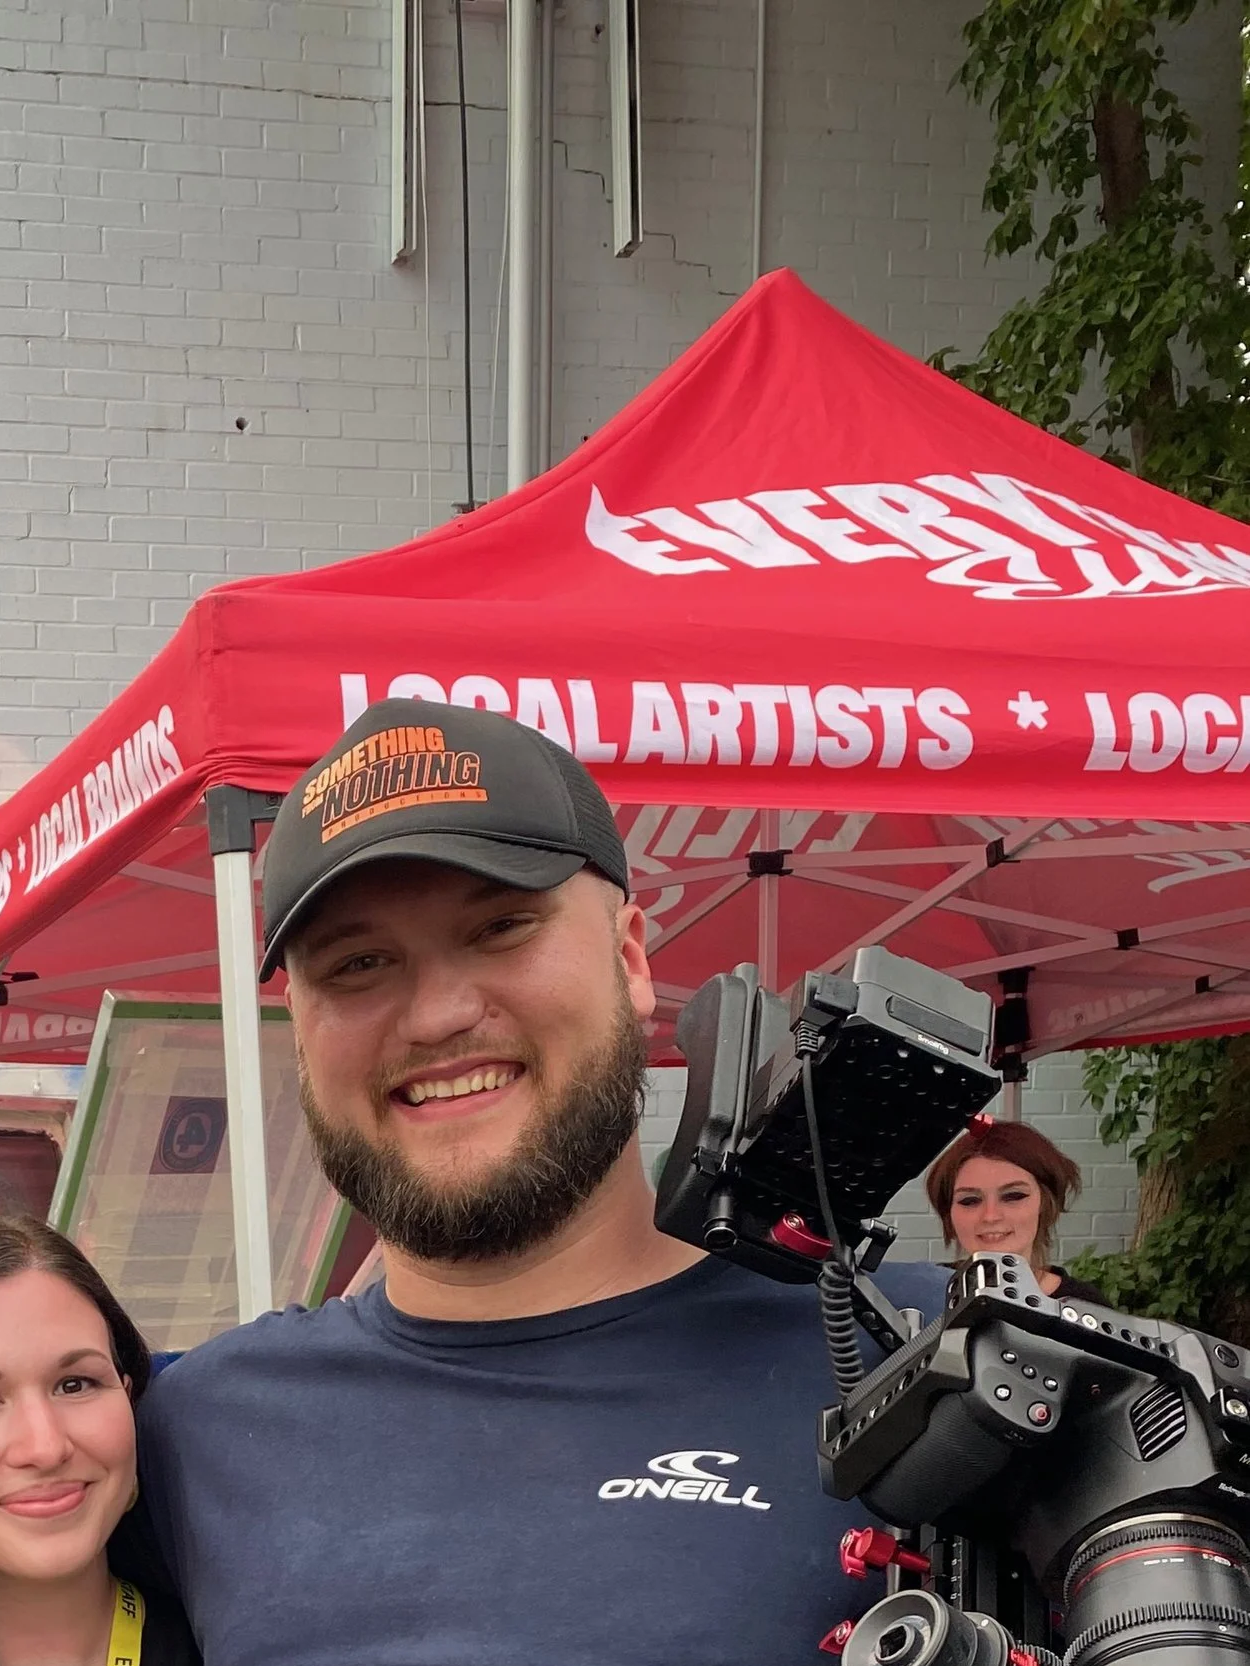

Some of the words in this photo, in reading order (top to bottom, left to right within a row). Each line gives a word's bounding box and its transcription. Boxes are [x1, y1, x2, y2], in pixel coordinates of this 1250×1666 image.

[303, 726, 446, 806] SOMETHING
[622, 681, 974, 770] ARTISTS
[23, 784, 86, 896] LOCAL
[81, 704, 185, 846] BRANDS
[321, 751, 482, 828] NOTHING
